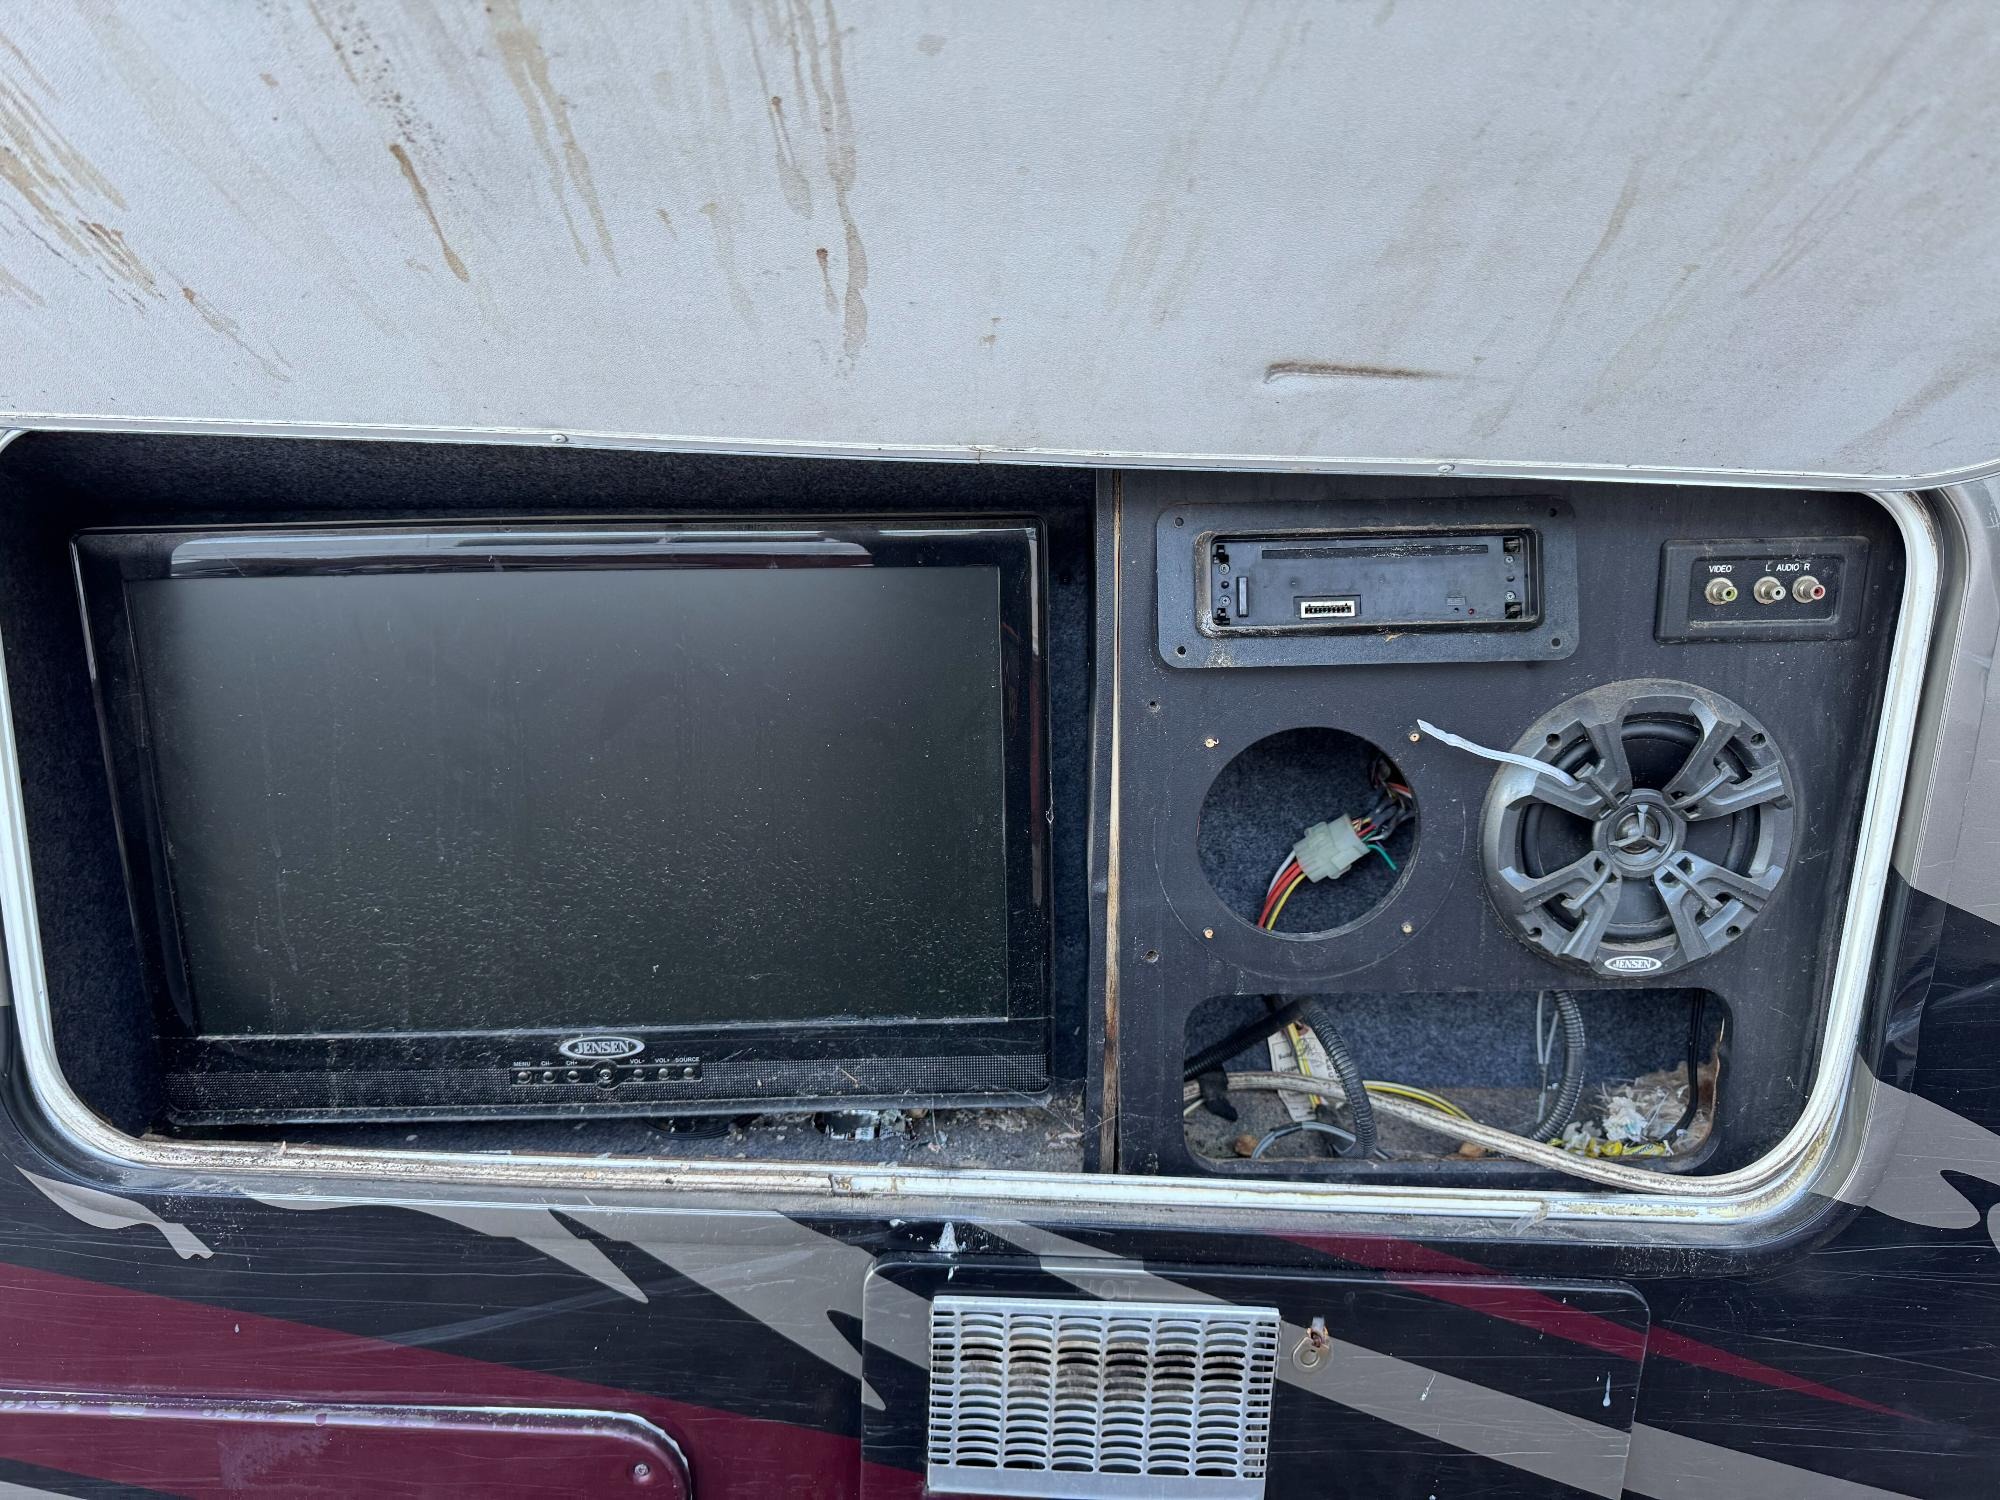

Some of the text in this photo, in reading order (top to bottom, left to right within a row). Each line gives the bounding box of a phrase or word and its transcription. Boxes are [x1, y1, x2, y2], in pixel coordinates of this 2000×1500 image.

[1708, 565, 1733, 573] VIDEO
[1765, 563, 1811, 572] L AUDIO R
[1612, 959, 1651, 969] JENSEN
[574, 1040, 630, 1054] JENSEN
[1075, 1279, 1140, 1300] HOT
